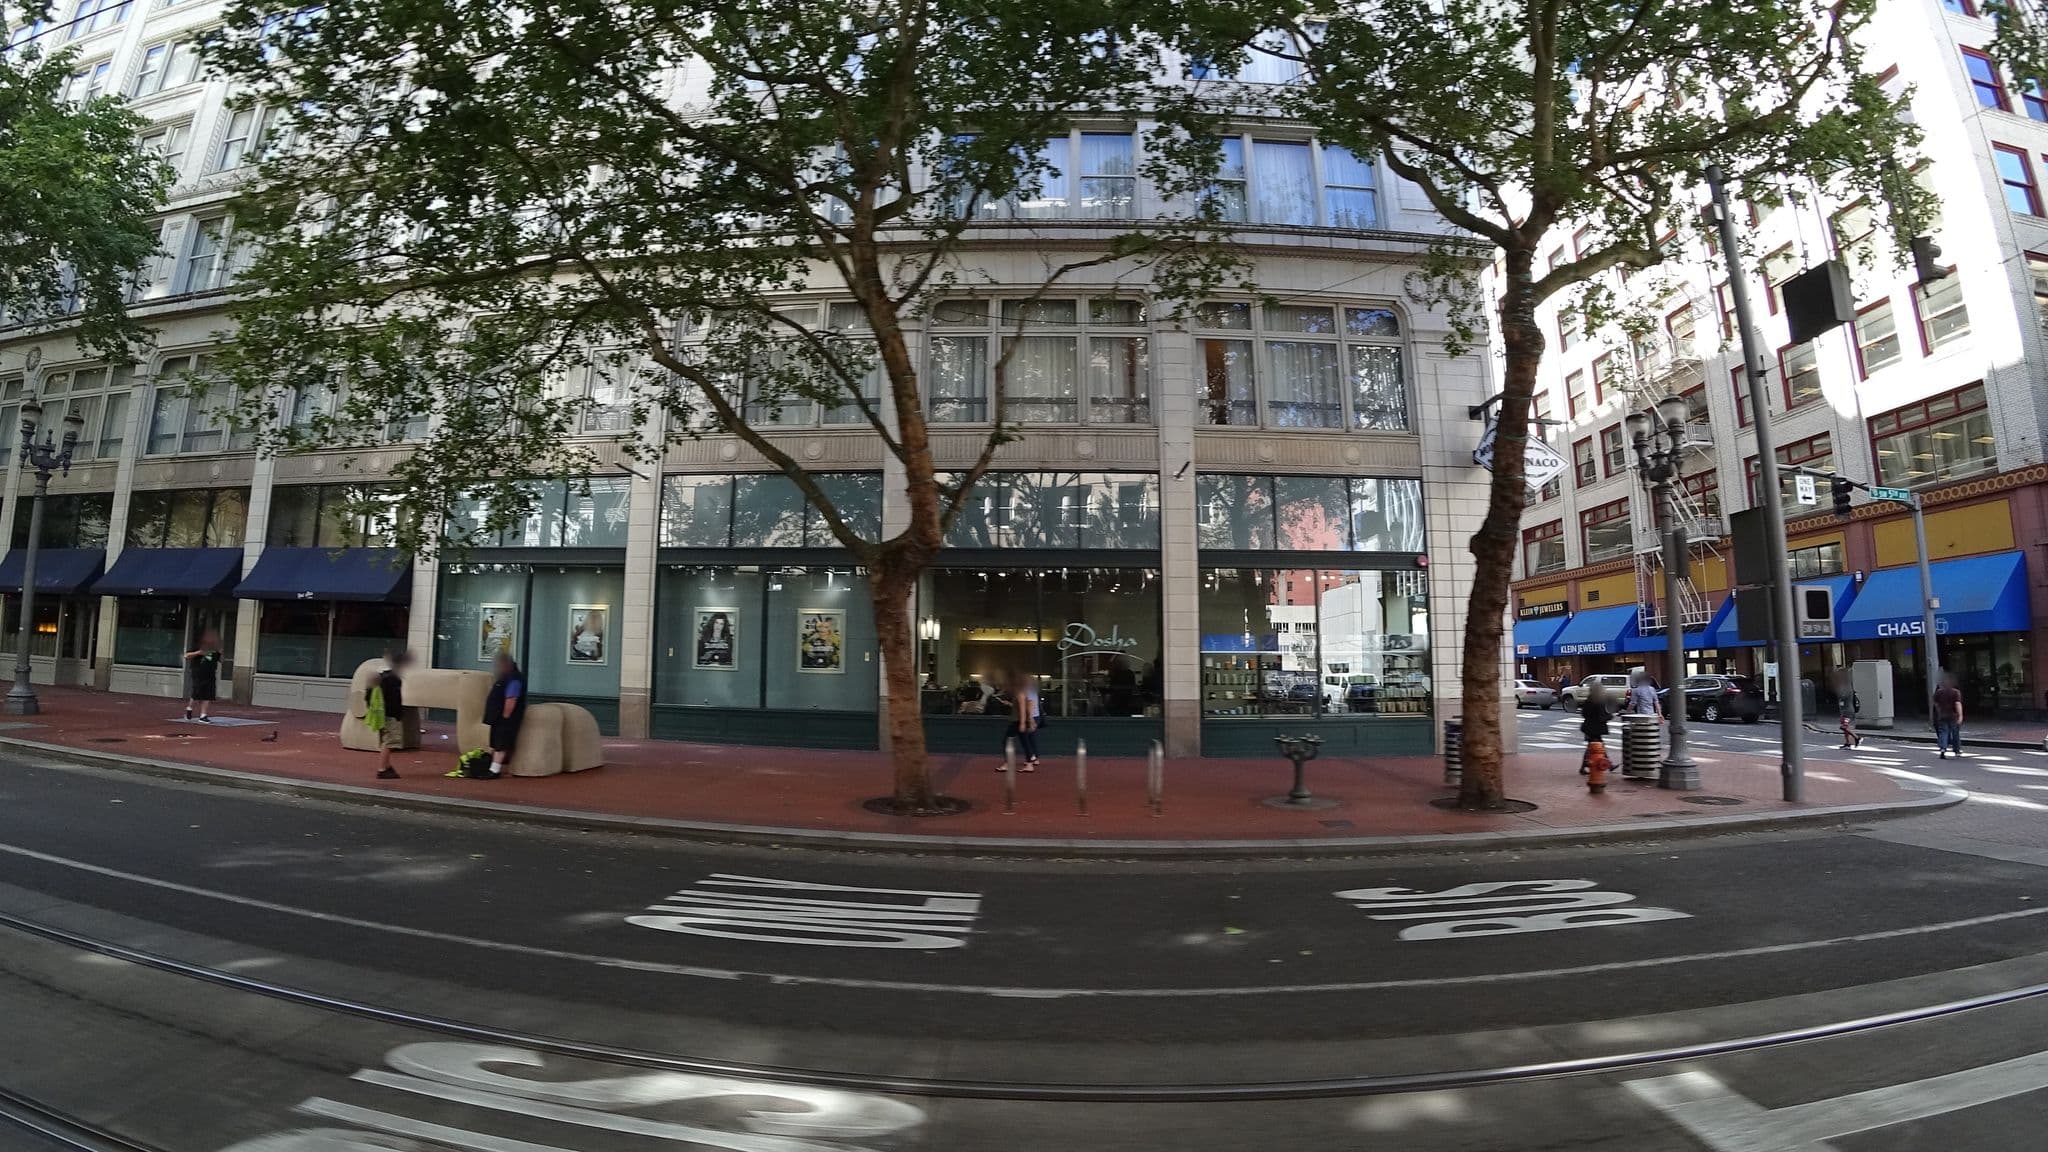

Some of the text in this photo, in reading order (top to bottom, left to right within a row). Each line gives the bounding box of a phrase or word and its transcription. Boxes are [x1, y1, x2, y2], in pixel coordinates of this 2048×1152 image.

[1519, 602, 1564, 616] KLEIN JEWELERS
[1057, 622, 1138, 651] Dosha
[1878, 622, 1926, 636] CHAS
[1560, 643, 1606, 654] KLEIN JEWELERS
[623, 872, 983, 950] ONLY
[1332, 878, 1696, 942] BUS
